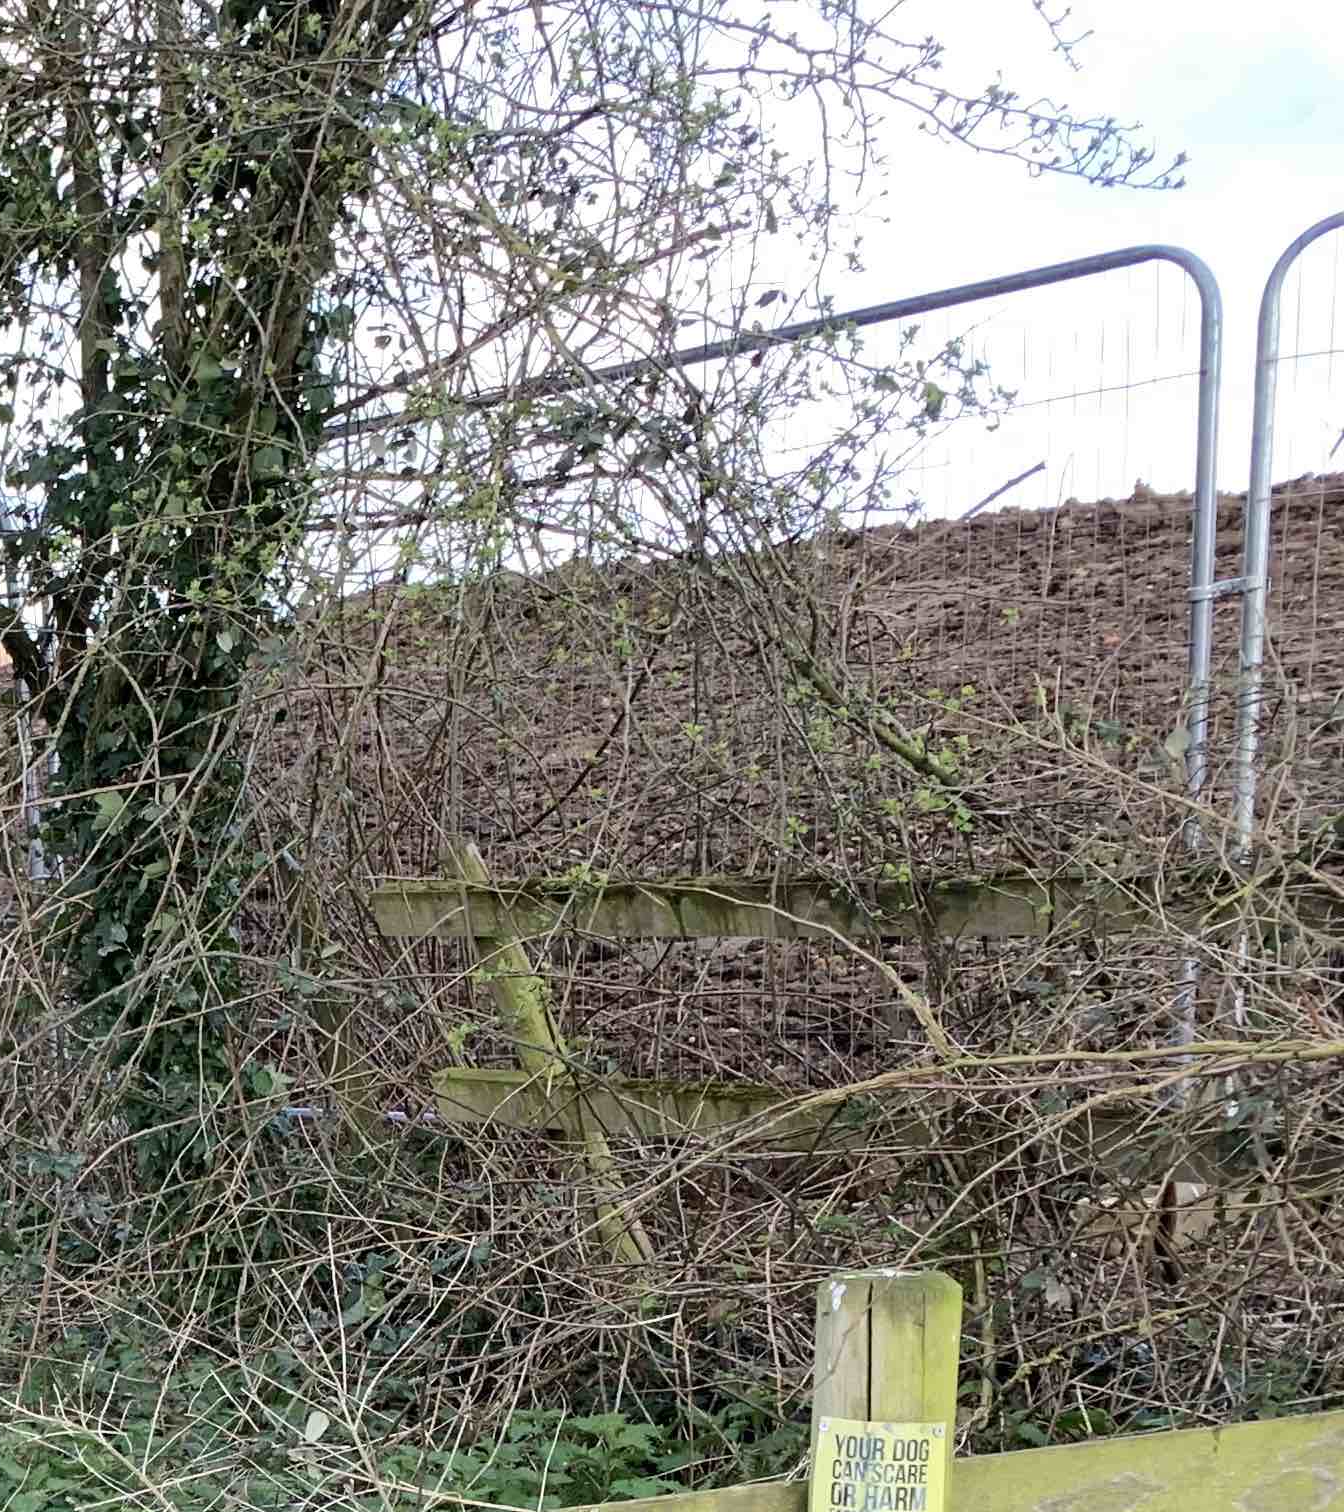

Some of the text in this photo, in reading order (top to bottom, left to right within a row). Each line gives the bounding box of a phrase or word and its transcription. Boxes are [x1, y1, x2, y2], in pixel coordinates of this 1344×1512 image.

[835, 1434, 929, 1462] YOUR DOG
[832, 1459, 928, 1484] CAN SCARE
[831, 1482, 926, 1511] OR HARM
